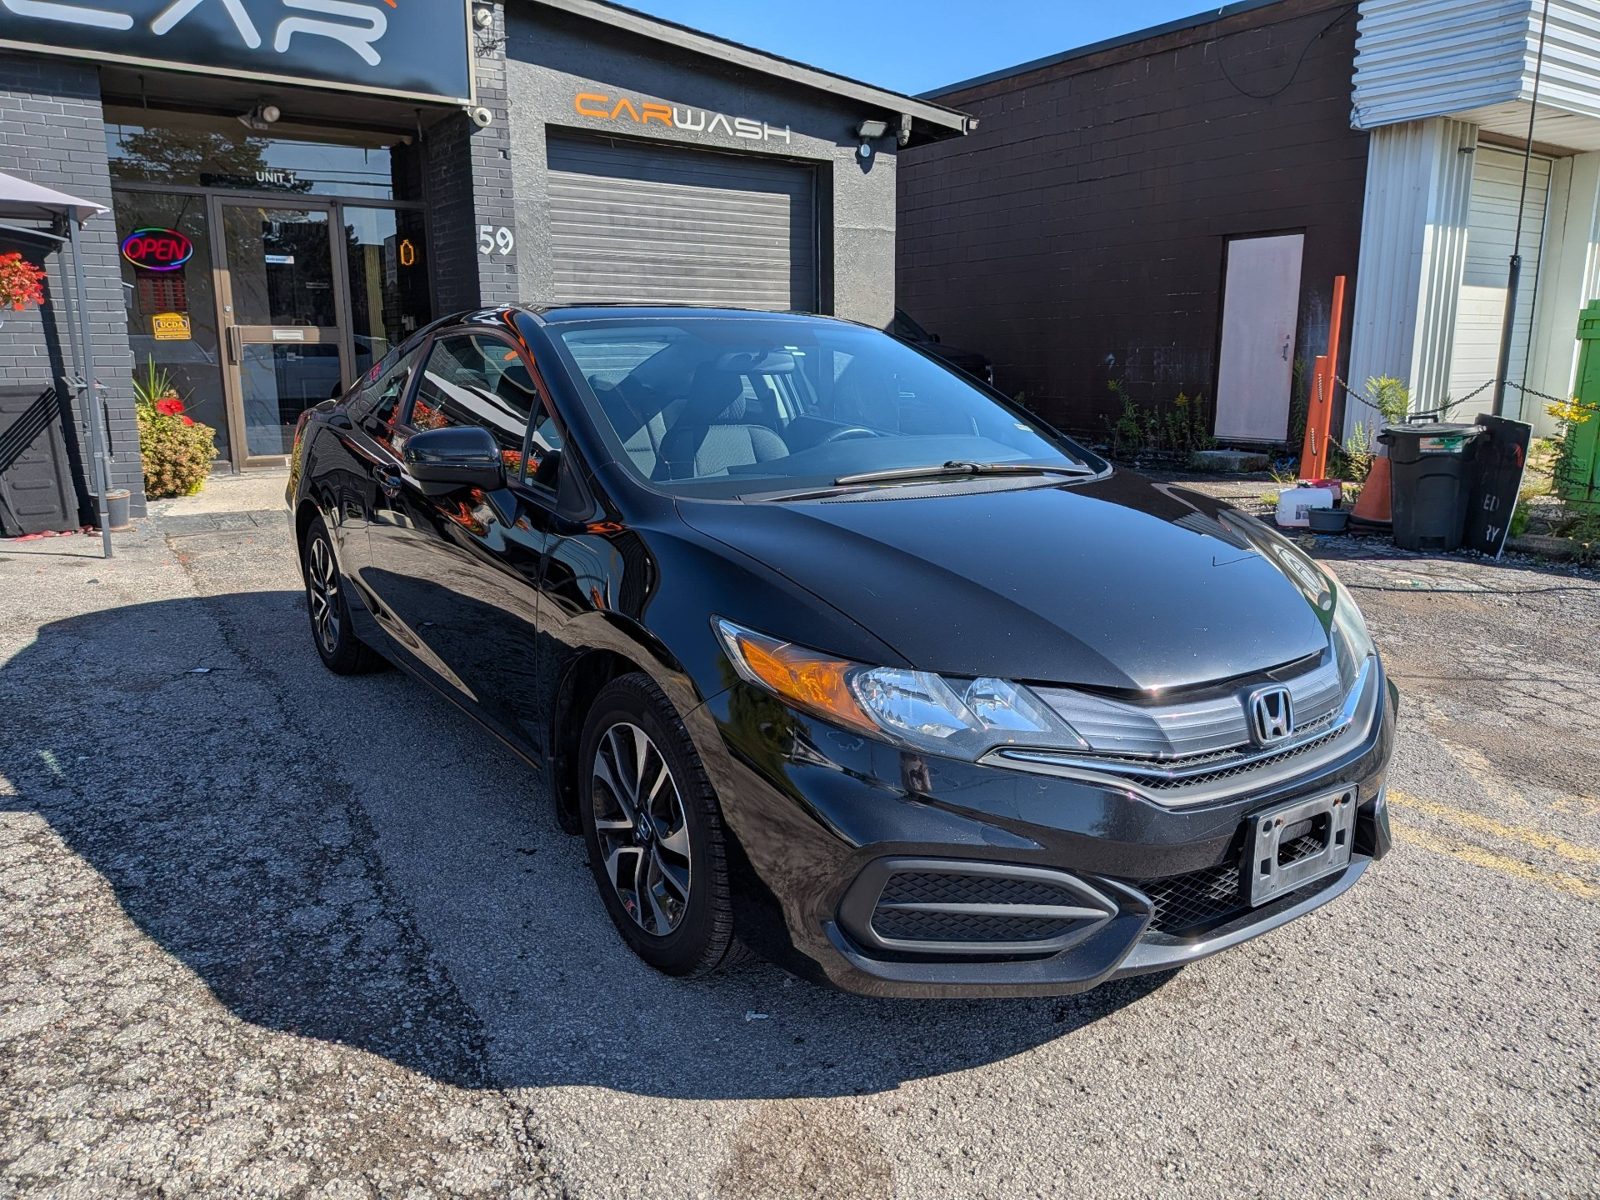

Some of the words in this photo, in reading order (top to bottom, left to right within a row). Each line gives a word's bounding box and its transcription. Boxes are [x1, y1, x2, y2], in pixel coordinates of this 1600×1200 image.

[574, 92, 791, 145] CARWASH
[256, 171, 285, 184] UNIT
[288, 174, 295, 185] 1
[125, 237, 187, 261] OPEN
[478, 225, 515, 256] 59
[159, 321, 185, 329] UCDA
